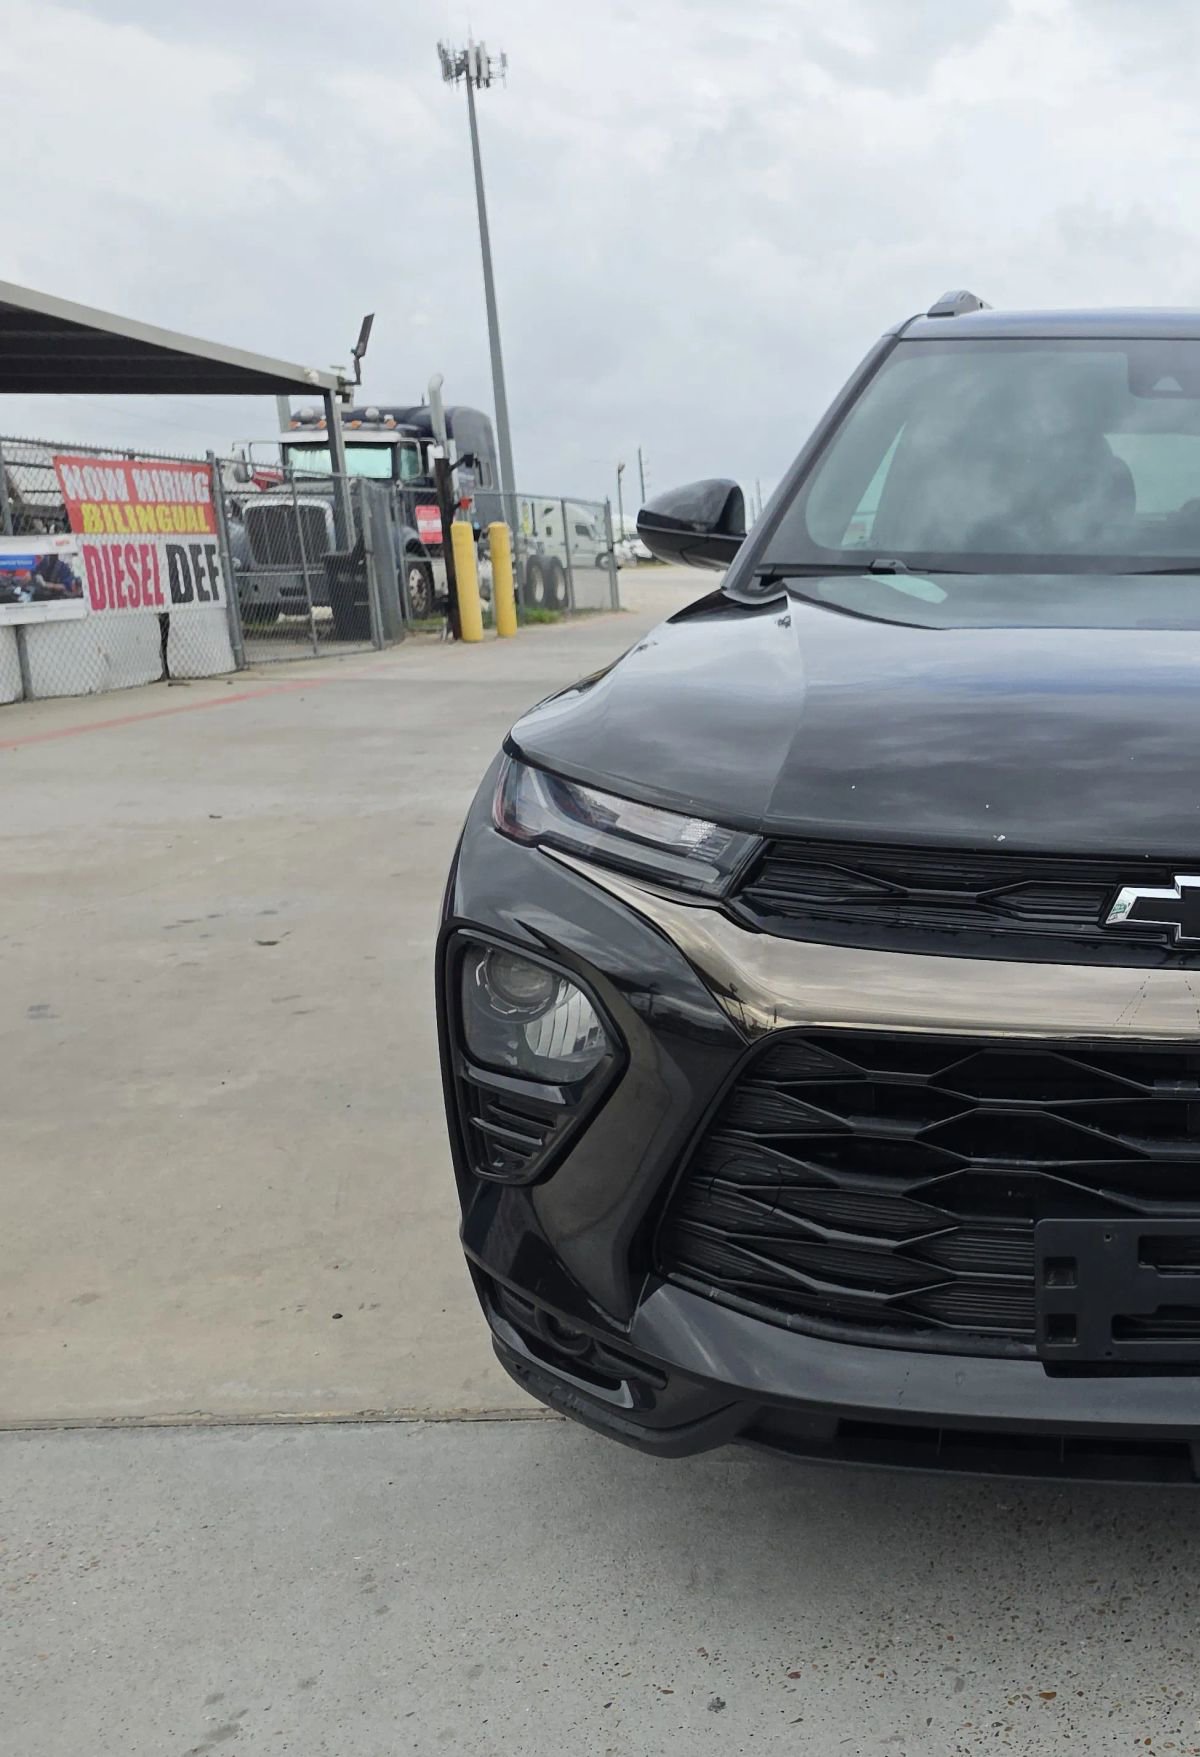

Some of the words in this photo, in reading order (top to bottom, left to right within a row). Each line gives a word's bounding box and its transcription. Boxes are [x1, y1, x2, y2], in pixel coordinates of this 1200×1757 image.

[59, 464, 129, 501] NOW
[131, 469, 210, 503] HIRING
[81, 502, 210, 533] BILINGUAL
[82, 543, 165, 611] DIESEL
[165, 544, 220, 604] DEF
